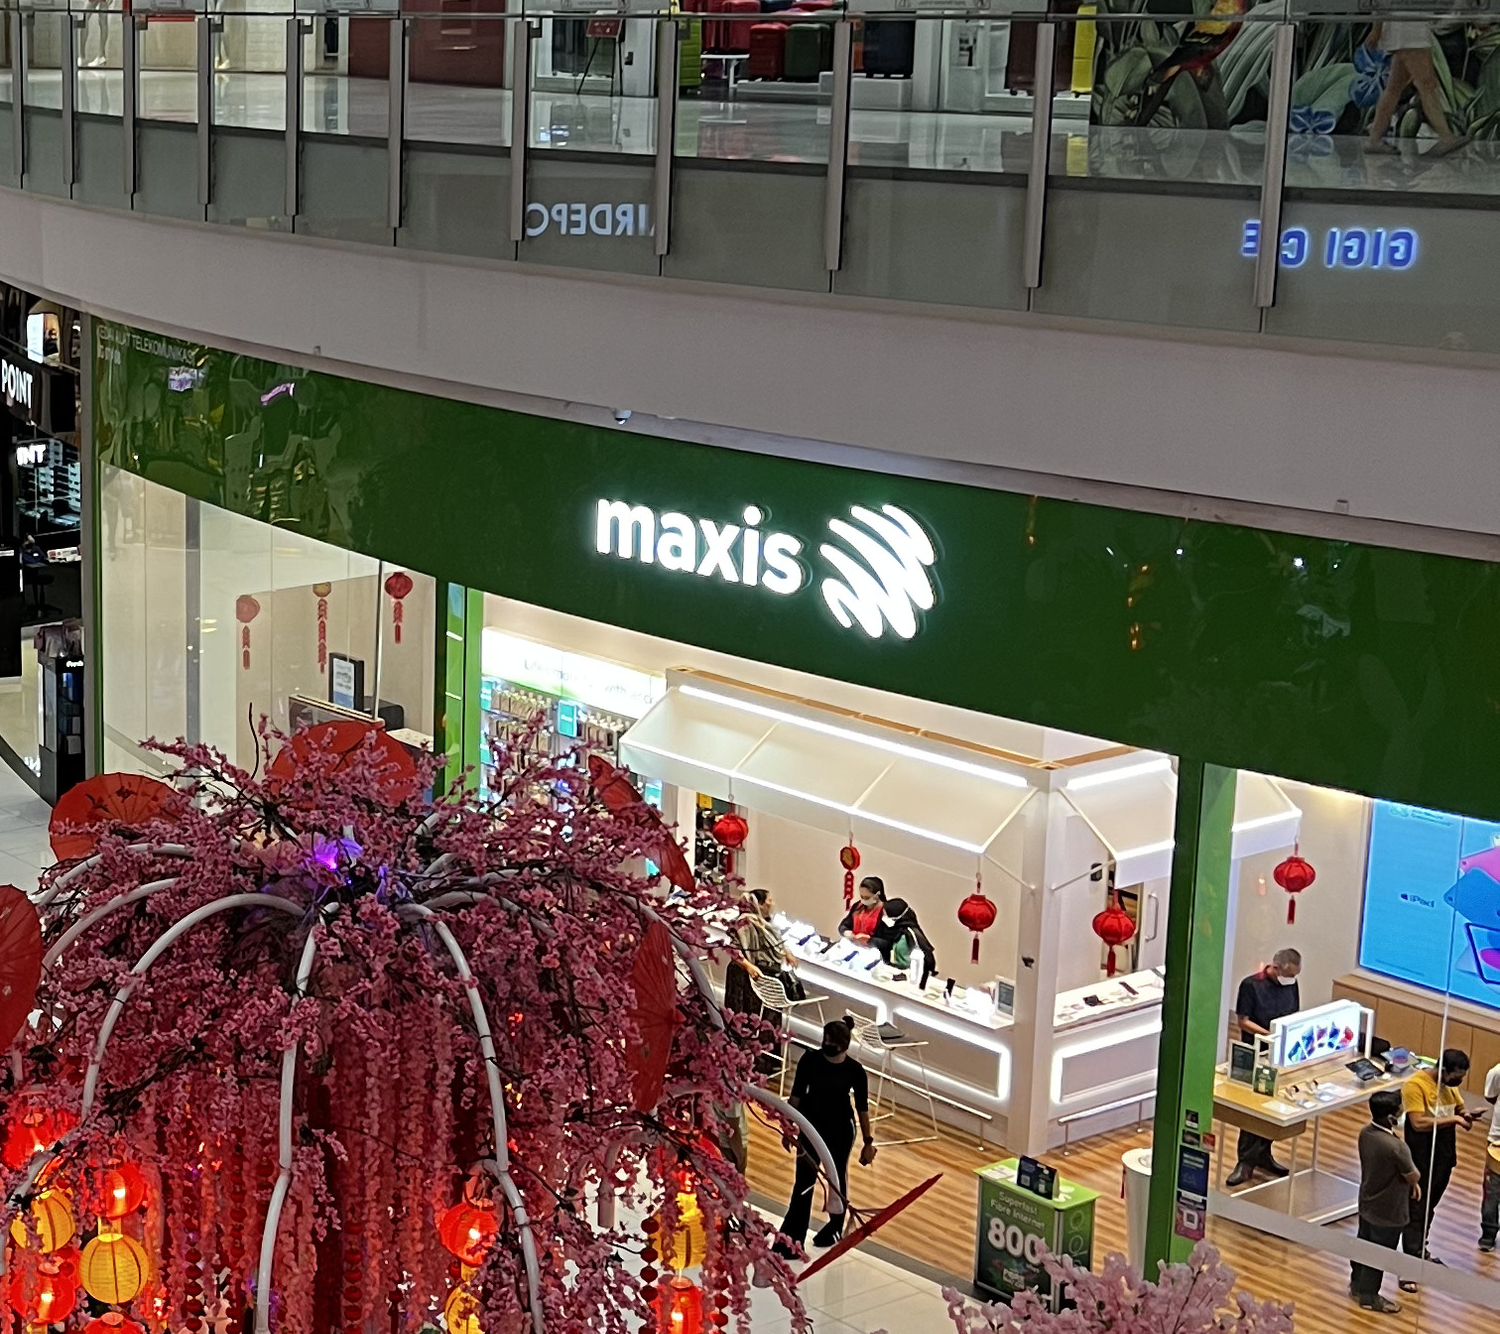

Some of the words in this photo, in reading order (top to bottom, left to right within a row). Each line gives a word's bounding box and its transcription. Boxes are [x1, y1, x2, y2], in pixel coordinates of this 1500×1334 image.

[1, 356, 35, 410] POINT
[596, 497, 803, 596] maxis
[1409, 893, 1436, 909] iPad
[987, 1216, 1042, 1266] 800
